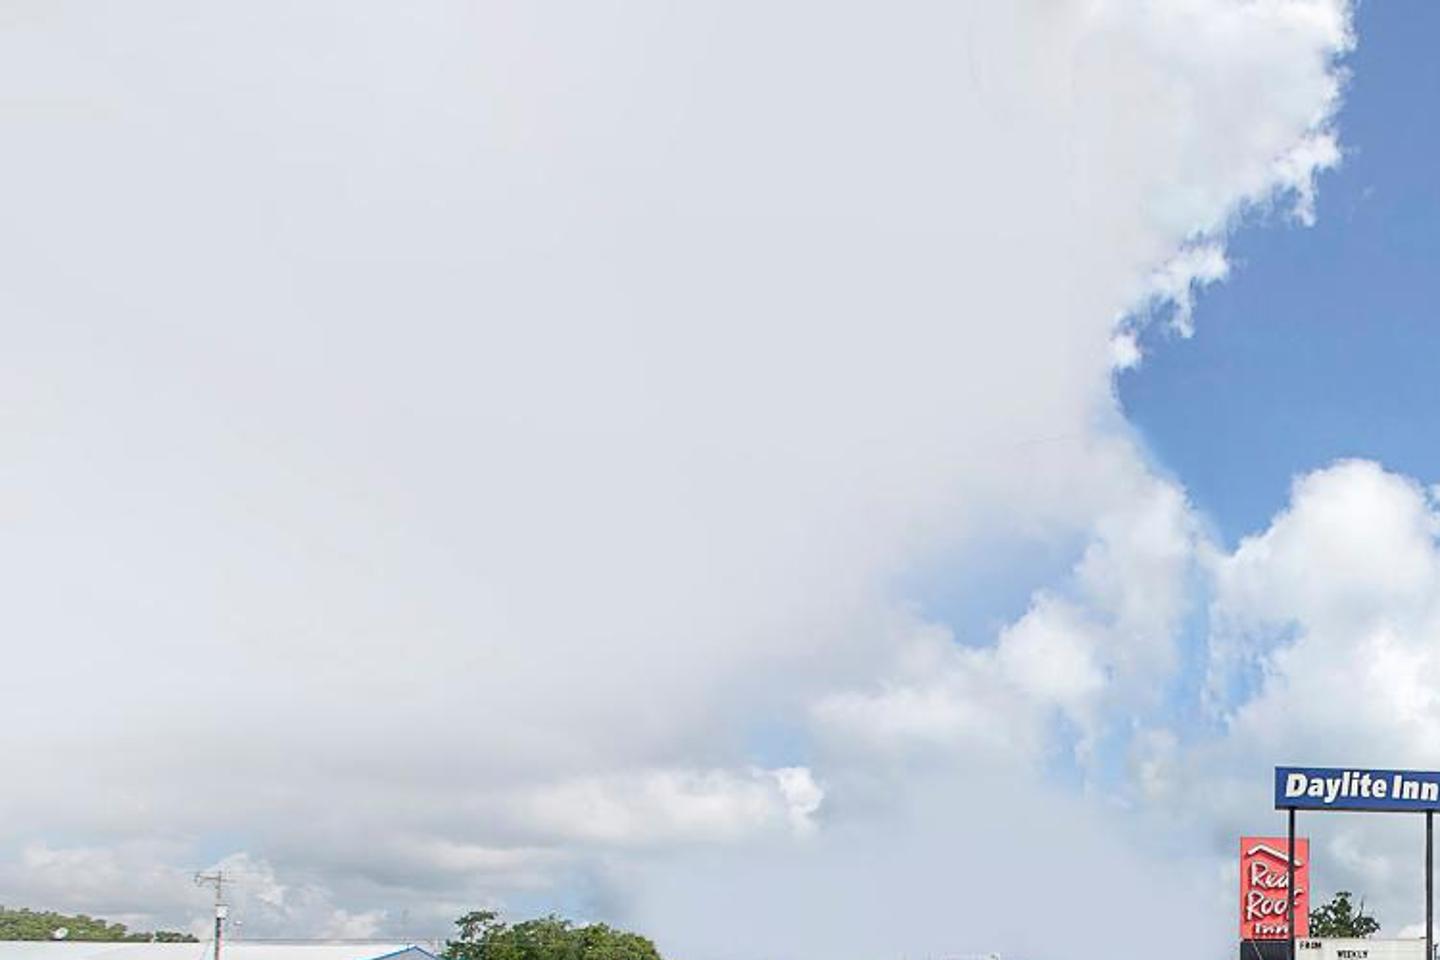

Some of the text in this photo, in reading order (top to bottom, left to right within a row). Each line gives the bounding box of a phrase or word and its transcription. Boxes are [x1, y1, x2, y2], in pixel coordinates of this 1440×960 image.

[1285, 772, 1439, 803] Daylite Inn
[1336, 950, 1368, 959] WEEKLY
